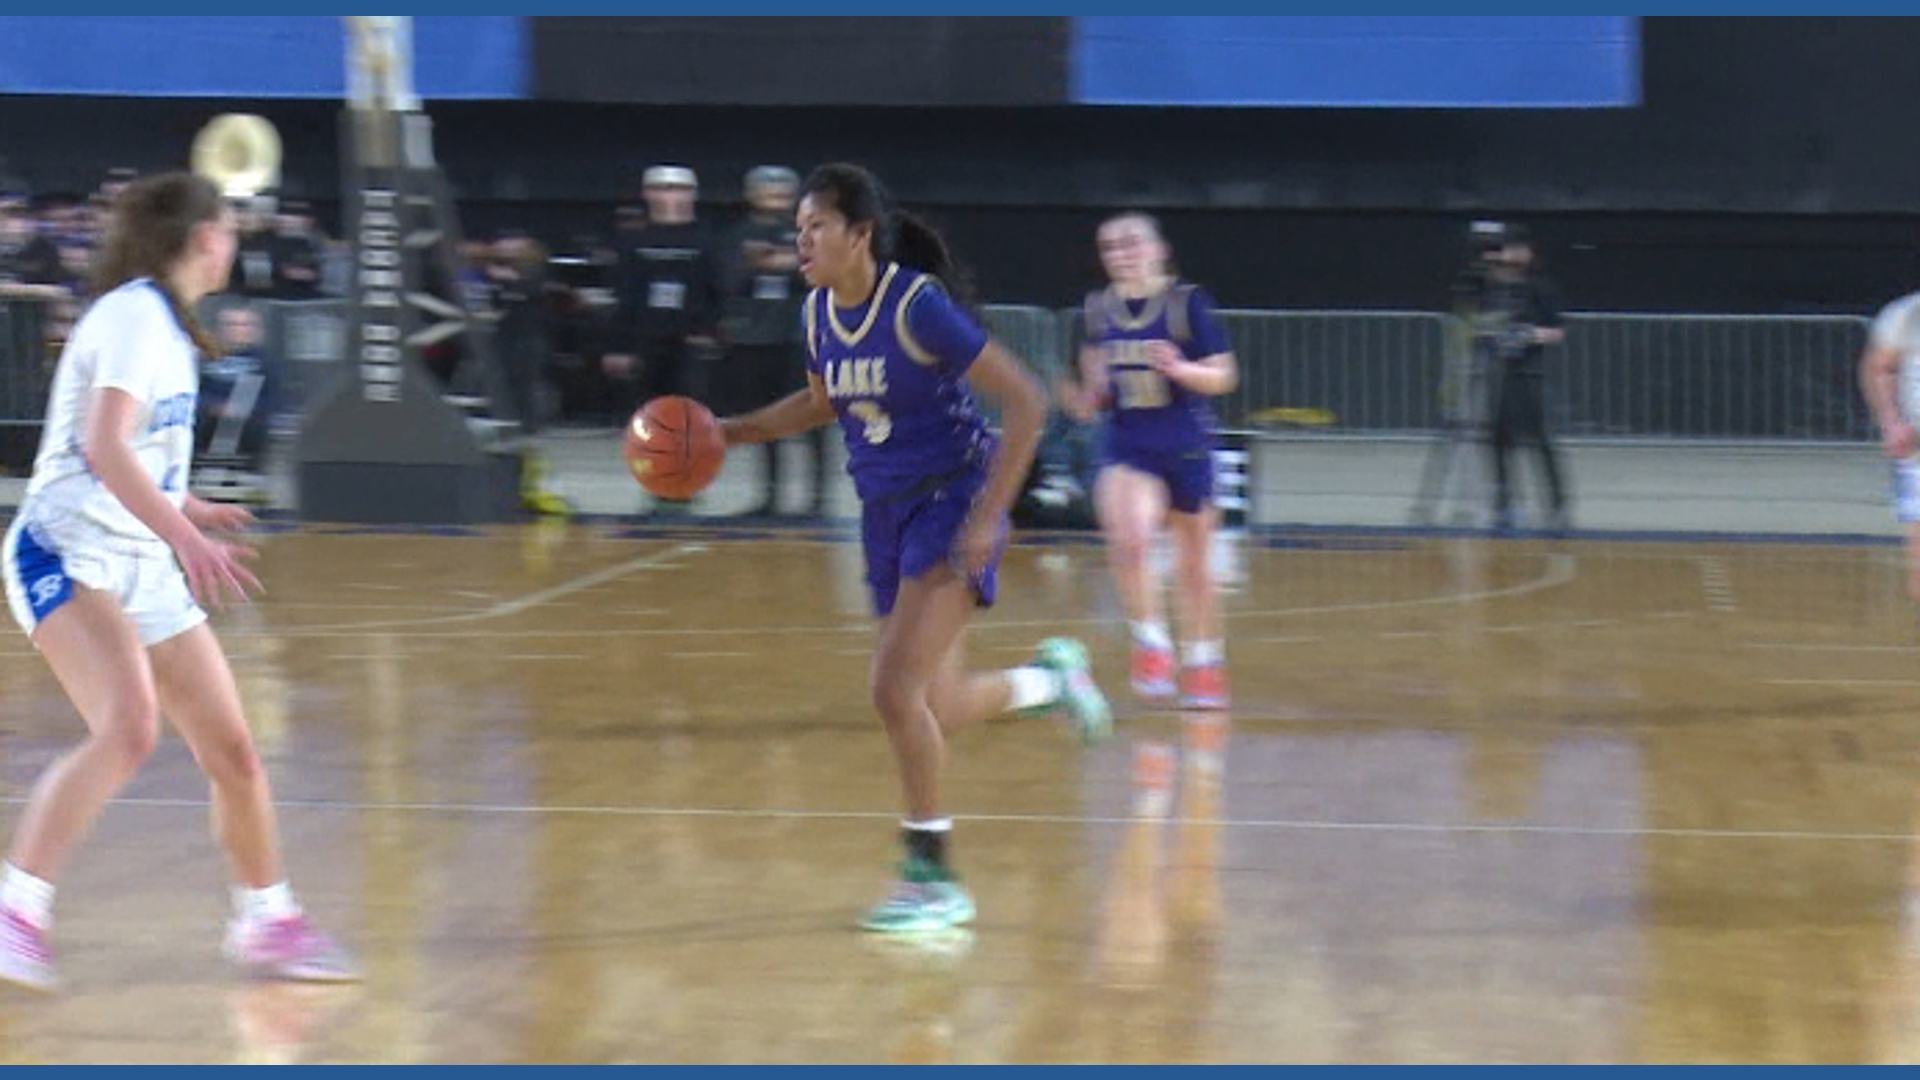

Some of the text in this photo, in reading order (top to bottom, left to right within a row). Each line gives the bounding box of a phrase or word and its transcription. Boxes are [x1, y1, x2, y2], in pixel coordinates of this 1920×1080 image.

[358, 188, 403, 402] TACOMA DOME
[824, 356, 889, 398] LAKE
